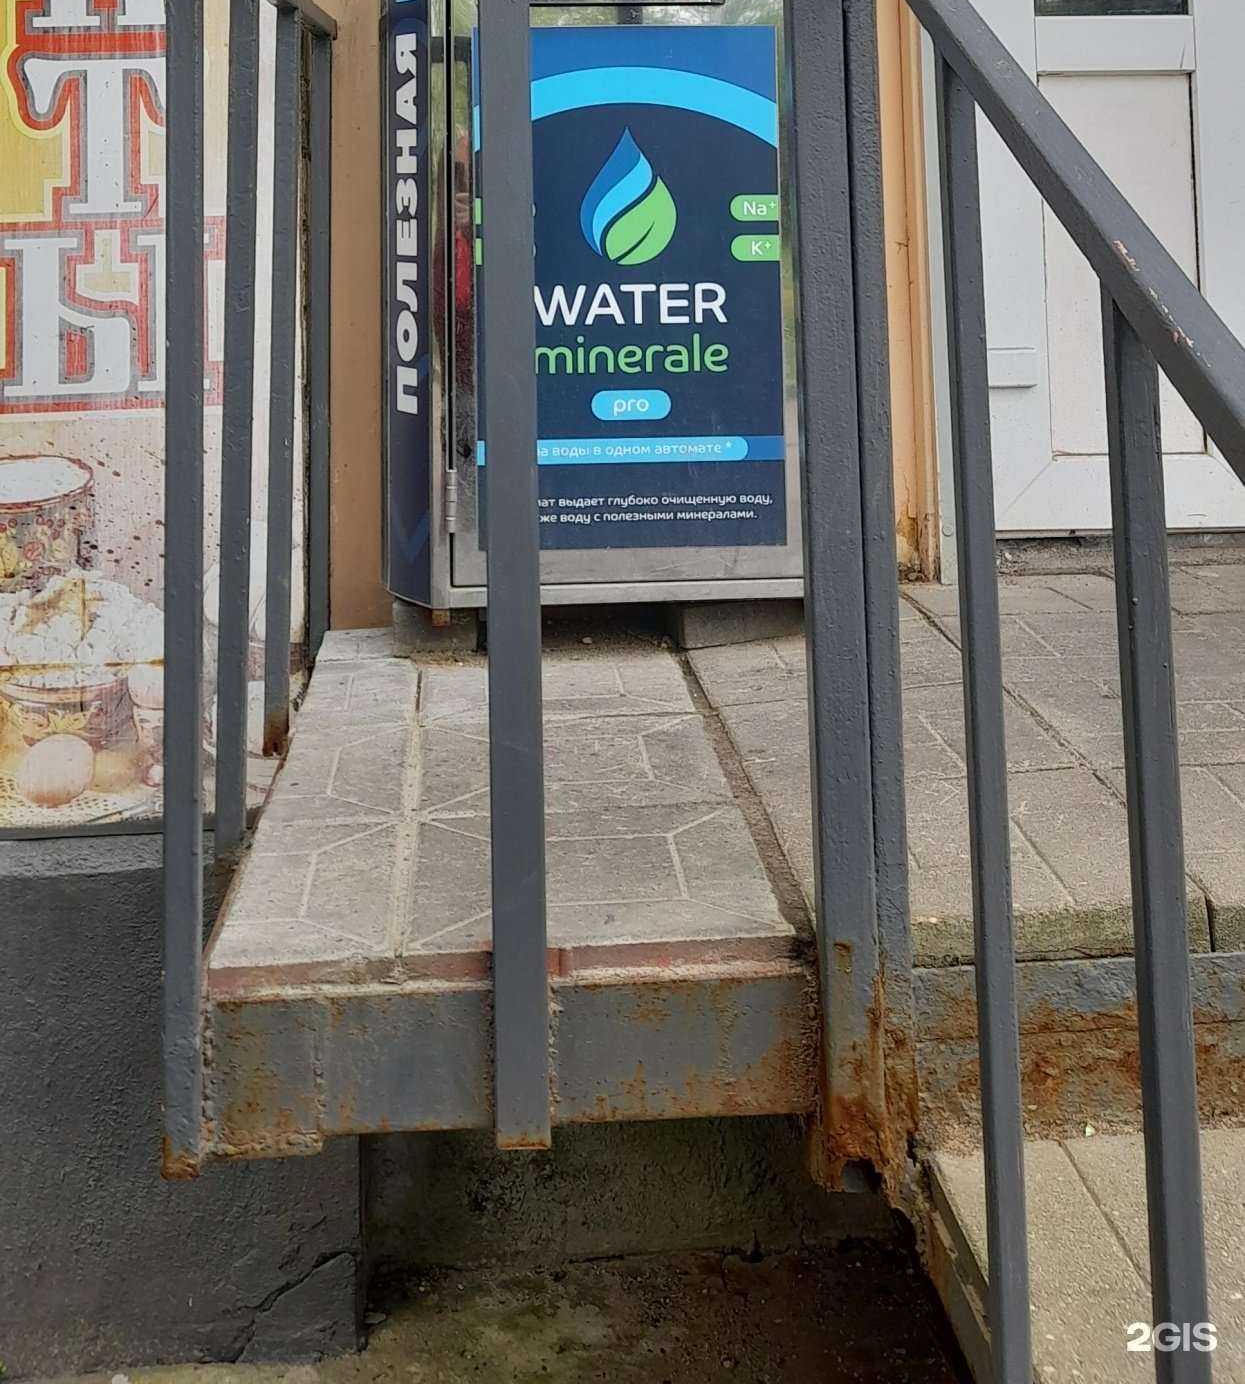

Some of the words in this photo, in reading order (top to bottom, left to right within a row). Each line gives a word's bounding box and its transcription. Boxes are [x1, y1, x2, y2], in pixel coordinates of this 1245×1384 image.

[743, 200, 776, 216] Na+
[395, 33, 418, 415] ПОЛЕЗНАЯ
[751, 240, 772, 256] K+
[533, 282, 728, 327] WATER
[534, 332, 729, 375] minerale
[613, 397, 650, 417] pro
[552, 447, 590, 458] воды
[593, 447, 601, 456] в
[605, 445, 650, 458] одном
[654, 443, 721, 455] автомате
[558, 497, 604, 509] выдает
[607, 494, 659, 509] глубоко
[661, 493, 737, 508] очищенную
[739, 494, 773, 507] воду,
[560, 513, 592, 525] воду
[593, 513, 601, 522] с
[603, 511, 674, 522] полезными
[676, 510, 757, 523] минералами.
